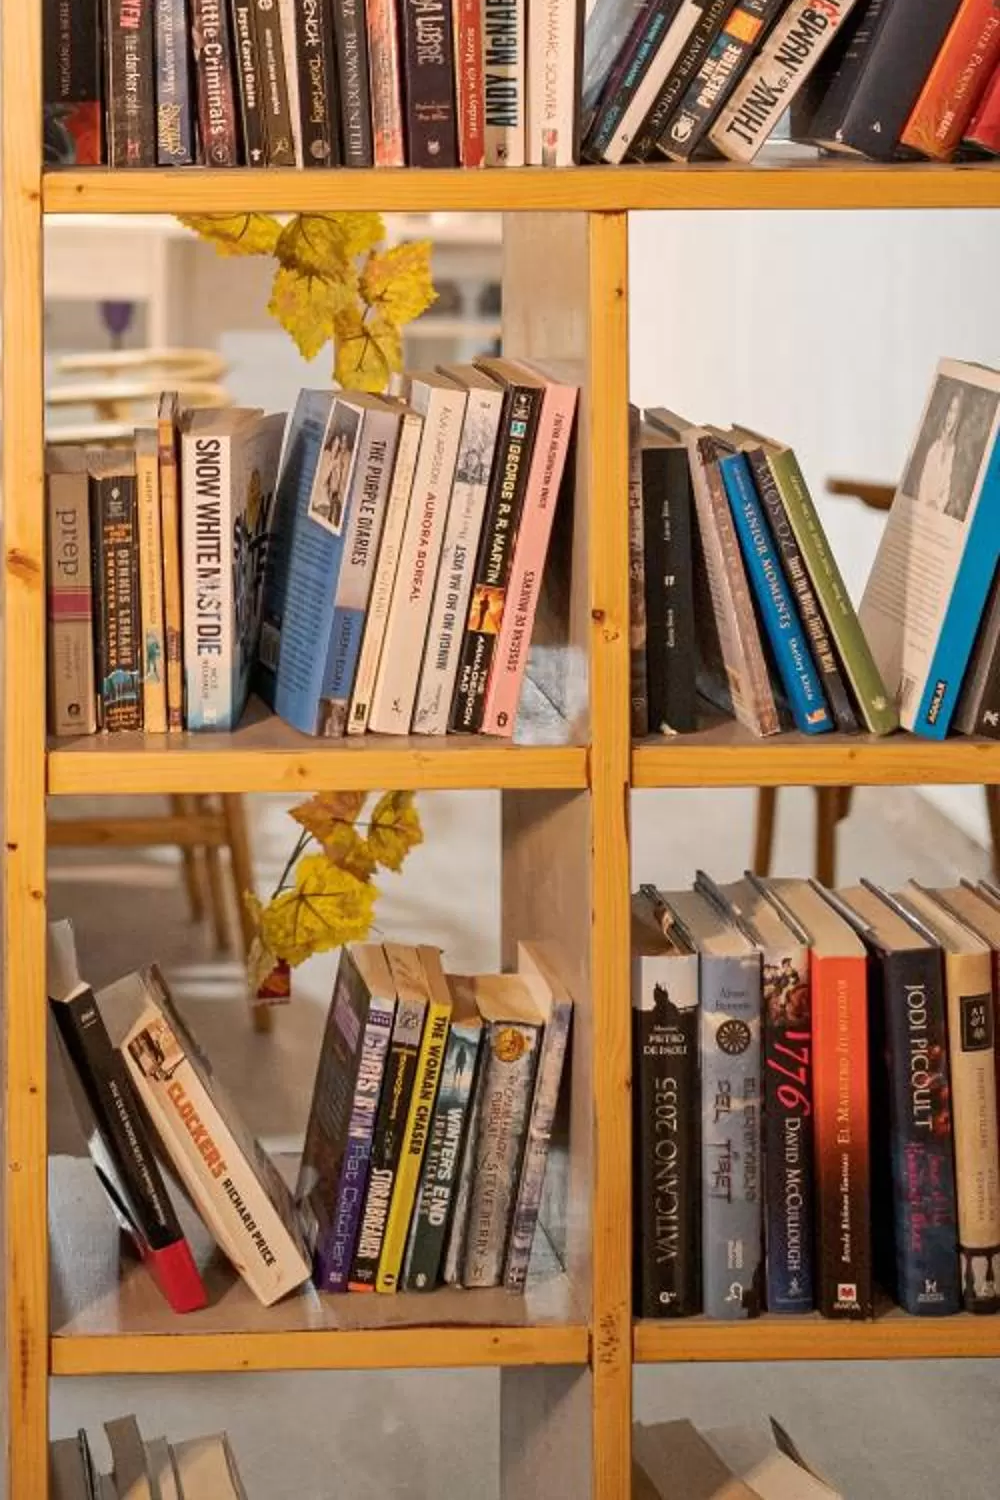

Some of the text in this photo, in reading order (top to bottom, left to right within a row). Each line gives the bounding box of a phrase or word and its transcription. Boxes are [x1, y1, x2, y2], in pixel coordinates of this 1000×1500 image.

[124, 52, 139, 91] darker
[203, 42, 227, 134] Criminals
[484, 73, 517, 126] ANDY
[695, 42, 744, 109] PRESTIGE
[696, 56, 717, 81] THE
[726, 78, 783, 145] THINK
[195, 439, 220, 499] SNOW
[349, 437, 388, 567] THE PURPLE DIARIES
[56, 508, 79, 575] prep
[196, 501, 220, 564] WHITE
[486, 443, 521, 583] GEORGE R. R. MARTIN
[118, 549, 131, 603] DENNIS
[408, 492, 437, 604] AURORA BOREAL
[451, 544, 467, 571] VIST
[741, 501, 792, 630] SENIOR MOMENTS
[196, 624, 221, 656] DIE
[357, 1037, 387, 1092] CHRIS
[410, 1014, 447, 1154] THE WOMAN CHASER
[766, 1030, 811, 1116] 1776
[904, 984, 932, 1129] JODI PICOULT
[168, 1081, 228, 1178] CLOCKERS
[351, 1095, 376, 1139] RYAN
[785, 1116, 801, 1162] DAVID
[652, 1077, 681, 1262] VATICANO 2035
[222, 1178, 276, 1267] RICHARD PRICE
[329, 1187, 359, 1267] Catcher
[429, 1186, 448, 1225] END
